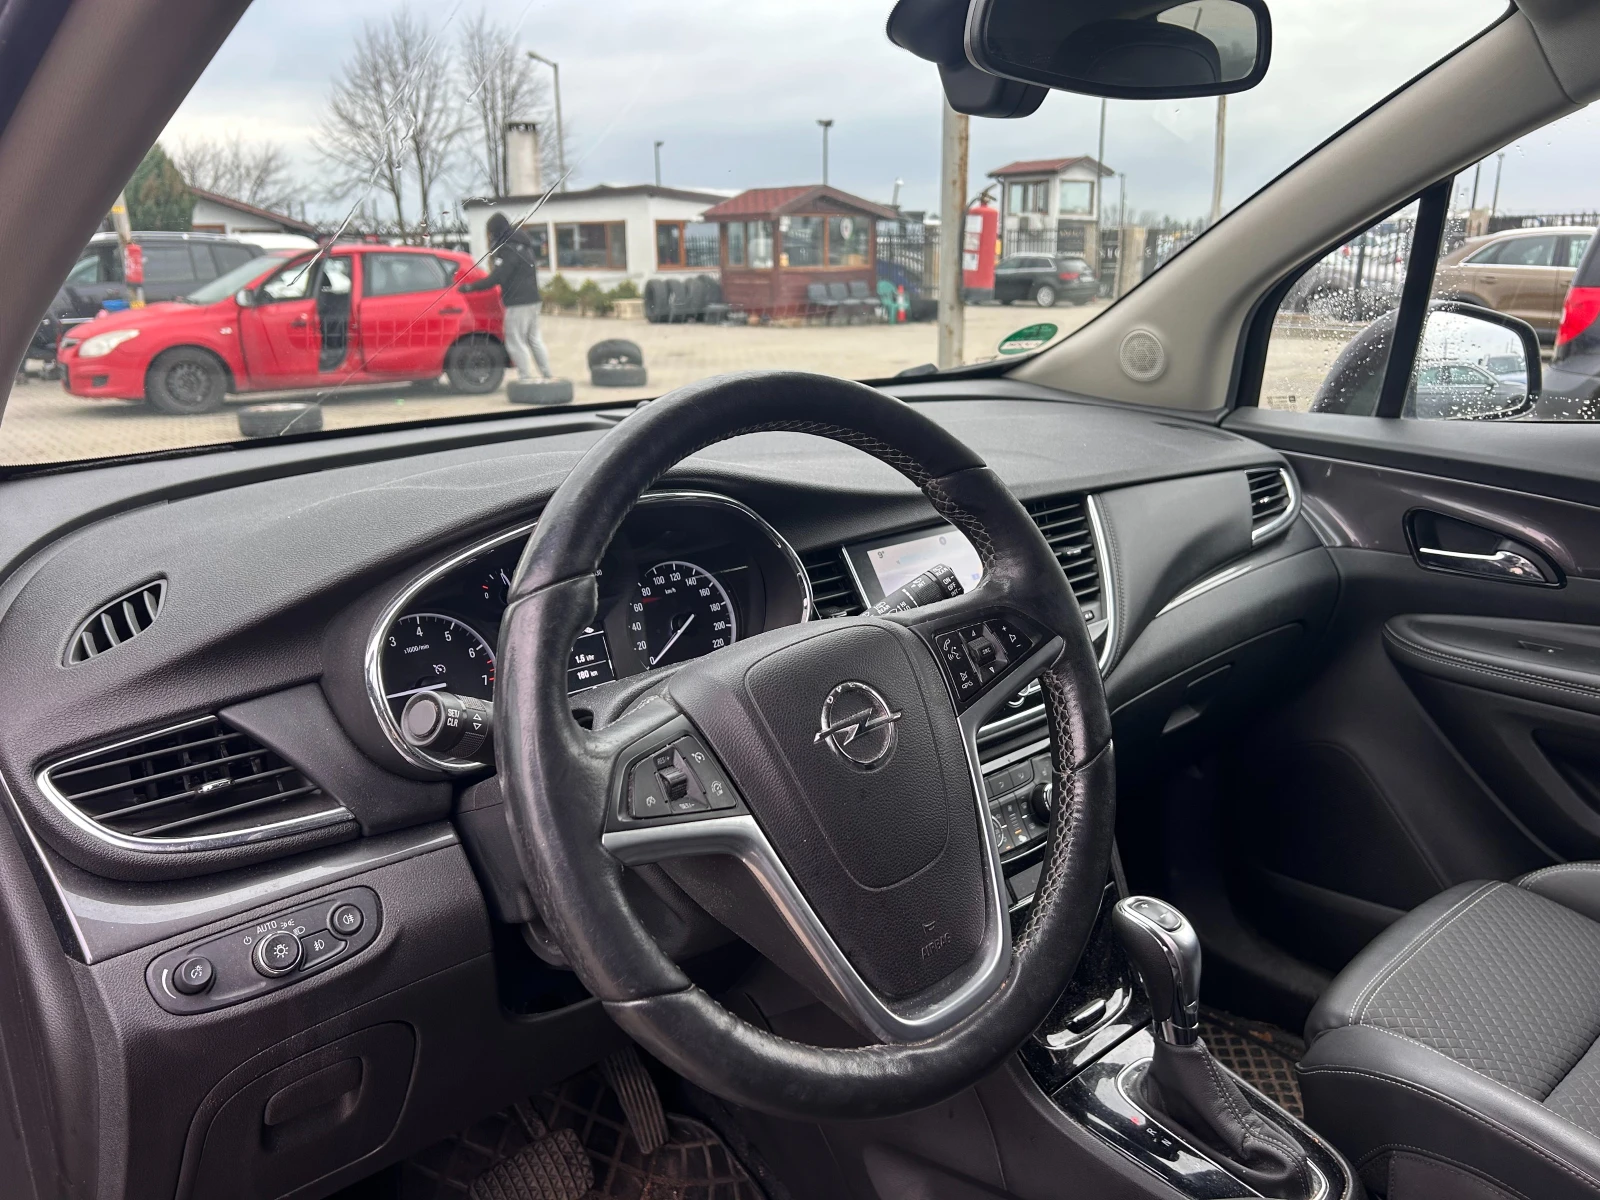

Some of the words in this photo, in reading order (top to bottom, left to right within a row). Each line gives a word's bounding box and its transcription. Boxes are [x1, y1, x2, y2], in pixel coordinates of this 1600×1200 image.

[653, 575, 665, 585] 100
[669, 573, 681, 582] 120
[685, 577, 697, 586] 140
[942, 577, 951, 585] ON
[665, 587, 676, 595] km/h
[947, 582, 956, 591] OFF
[641, 587, 651, 597] 80
[699, 587, 711, 597] 160
[633, 602, 643, 612] 60
[709, 602, 721, 612] 180
[631, 622, 642, 631] 40
[713, 621, 726, 631] 200
[416, 626, 423, 637] 4
[444, 631, 452, 642] 5
[389, 636, 397, 647] 3
[637, 641, 647, 651] 20
[712, 638, 725, 649] 220
[468, 648, 476, 658] 6
[481, 675, 488, 686] 7
[446, 717, 459, 727] CLR
[256, 920, 278, 935] AUTO
[1146, 1127, 1157, 1136] R
